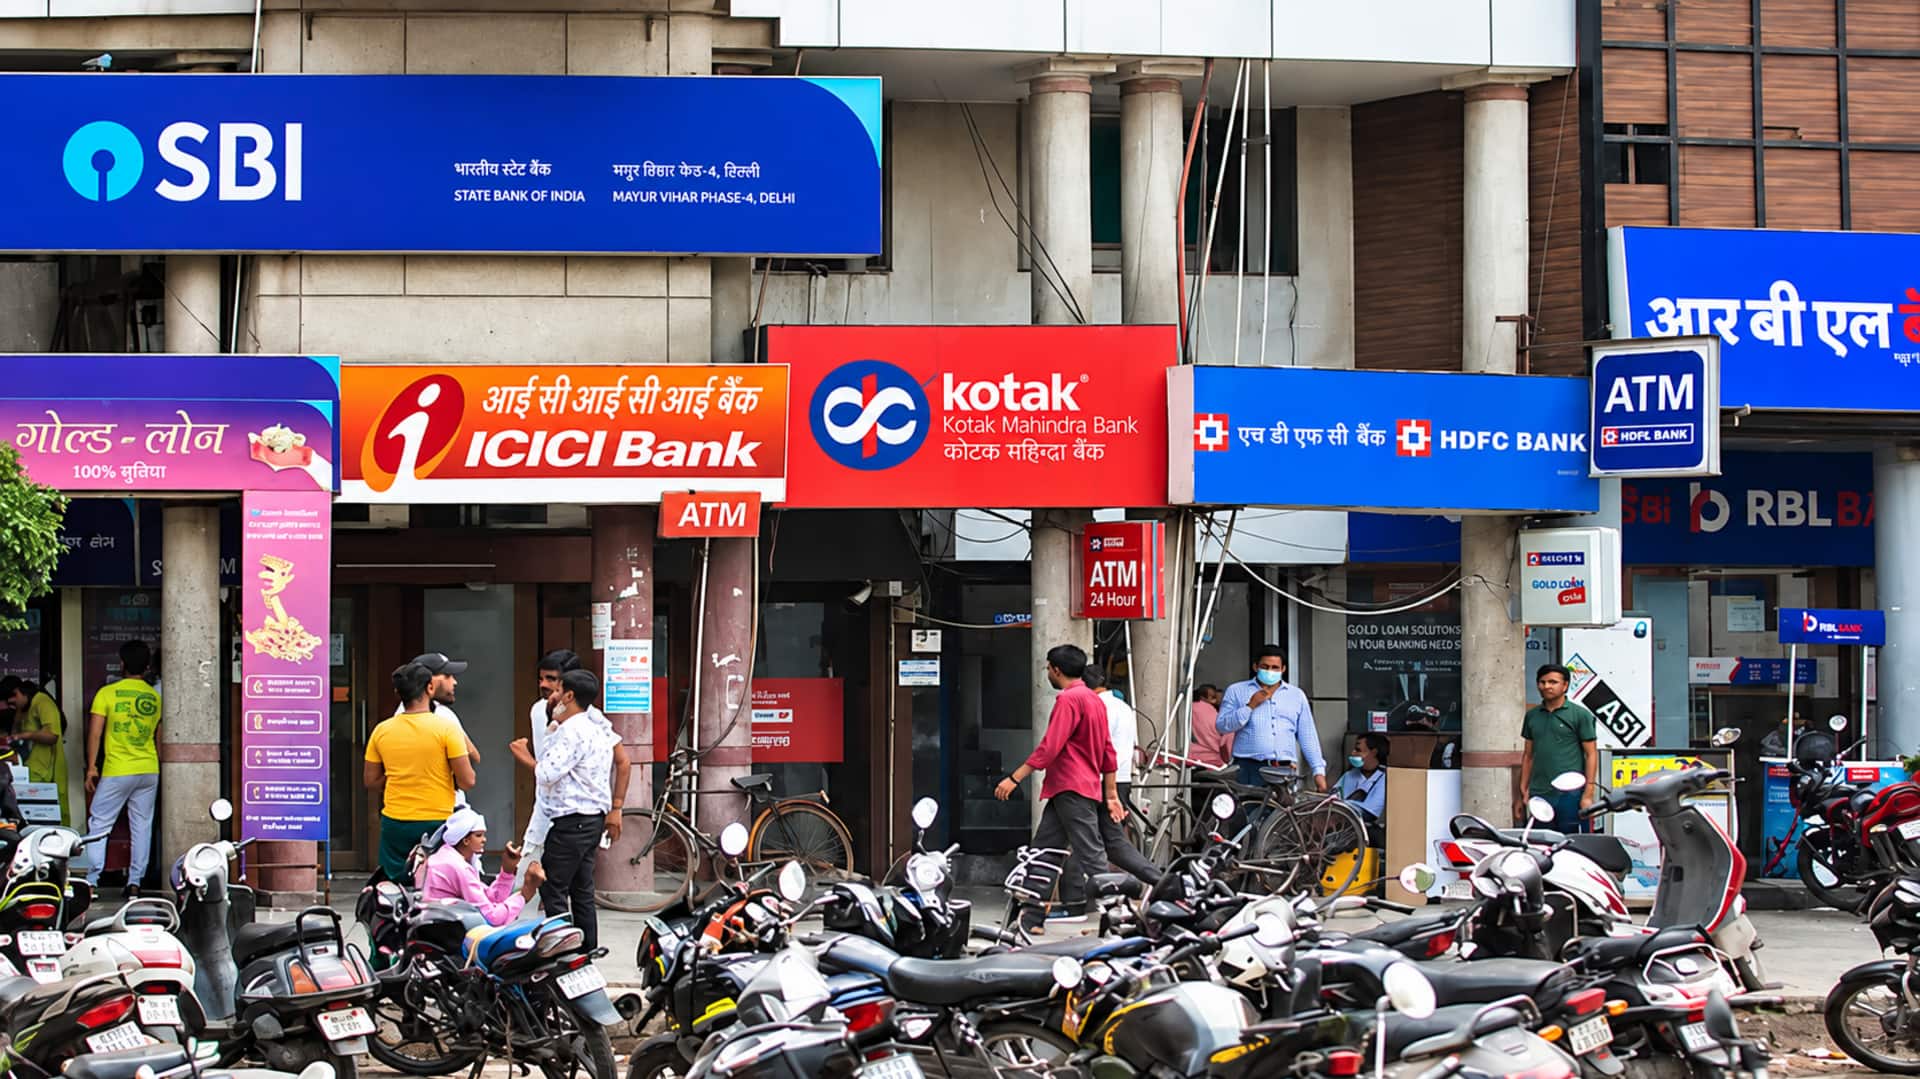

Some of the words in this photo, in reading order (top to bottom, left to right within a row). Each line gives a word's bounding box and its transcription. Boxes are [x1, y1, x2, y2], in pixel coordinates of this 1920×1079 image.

[154, 121, 303, 202] SBI
[454, 159, 499, 176] भारतीय
[502, 159, 527, 176] स्टेट
[454, 189, 491, 201] STATE
[494, 190, 528, 201] BANK
[531, 190, 548, 201] OF
[551, 190, 585, 202] INDIA
[613, 191, 657, 202] MAYUR
[659, 191, 698, 203] VIHAR
[701, 192, 757, 205] PHASE-4,
[759, 192, 796, 204] DELHI
[1745, 280, 1806, 347] बी
[1812, 301, 1893, 358] एल
[482, 375, 539, 420] आई
[539, 375, 573, 414] सी
[571, 375, 629, 420] आई
[627, 375, 662, 414] सी
[661, 376, 718, 420] आई
[717, 376, 763, 415] बैंक
[1603, 373, 1694, 413] ATM
[16, 410, 118, 454] गोल्ड
[145, 410, 230, 454] लोन
[943, 416, 996, 434] Kotak
[1002, 416, 1087, 434] Mahindra
[1094, 416, 1139, 434] Bank
[1237, 427, 1266, 447] एच
[1269, 421, 1289, 444] डी
[1293, 428, 1324, 449] एफ
[1327, 422, 1349, 446] सी
[1356, 423, 1386, 446] बैंक
[1654, 429, 1687, 440] BANK
[464, 430, 606, 468] ICICI
[612, 431, 762, 468] Bank
[943, 437, 1001, 460] कोटक
[1073, 438, 1106, 460] बैंक
[1440, 430, 1509, 450] HDFC
[1516, 431, 1588, 453] BANK
[73, 464, 117, 479] 100%
[677, 502, 747, 527] ATM
[1747, 490, 1832, 526] RBL
[1090, 560, 1137, 587] ATM
[1532, 580, 1557, 589] GOLD
[1090, 592, 1105, 607] 24
[1107, 592, 1136, 607] Hour
[1347, 624, 1378, 635] GOLD
[1596, 700, 1642, 743] A51
